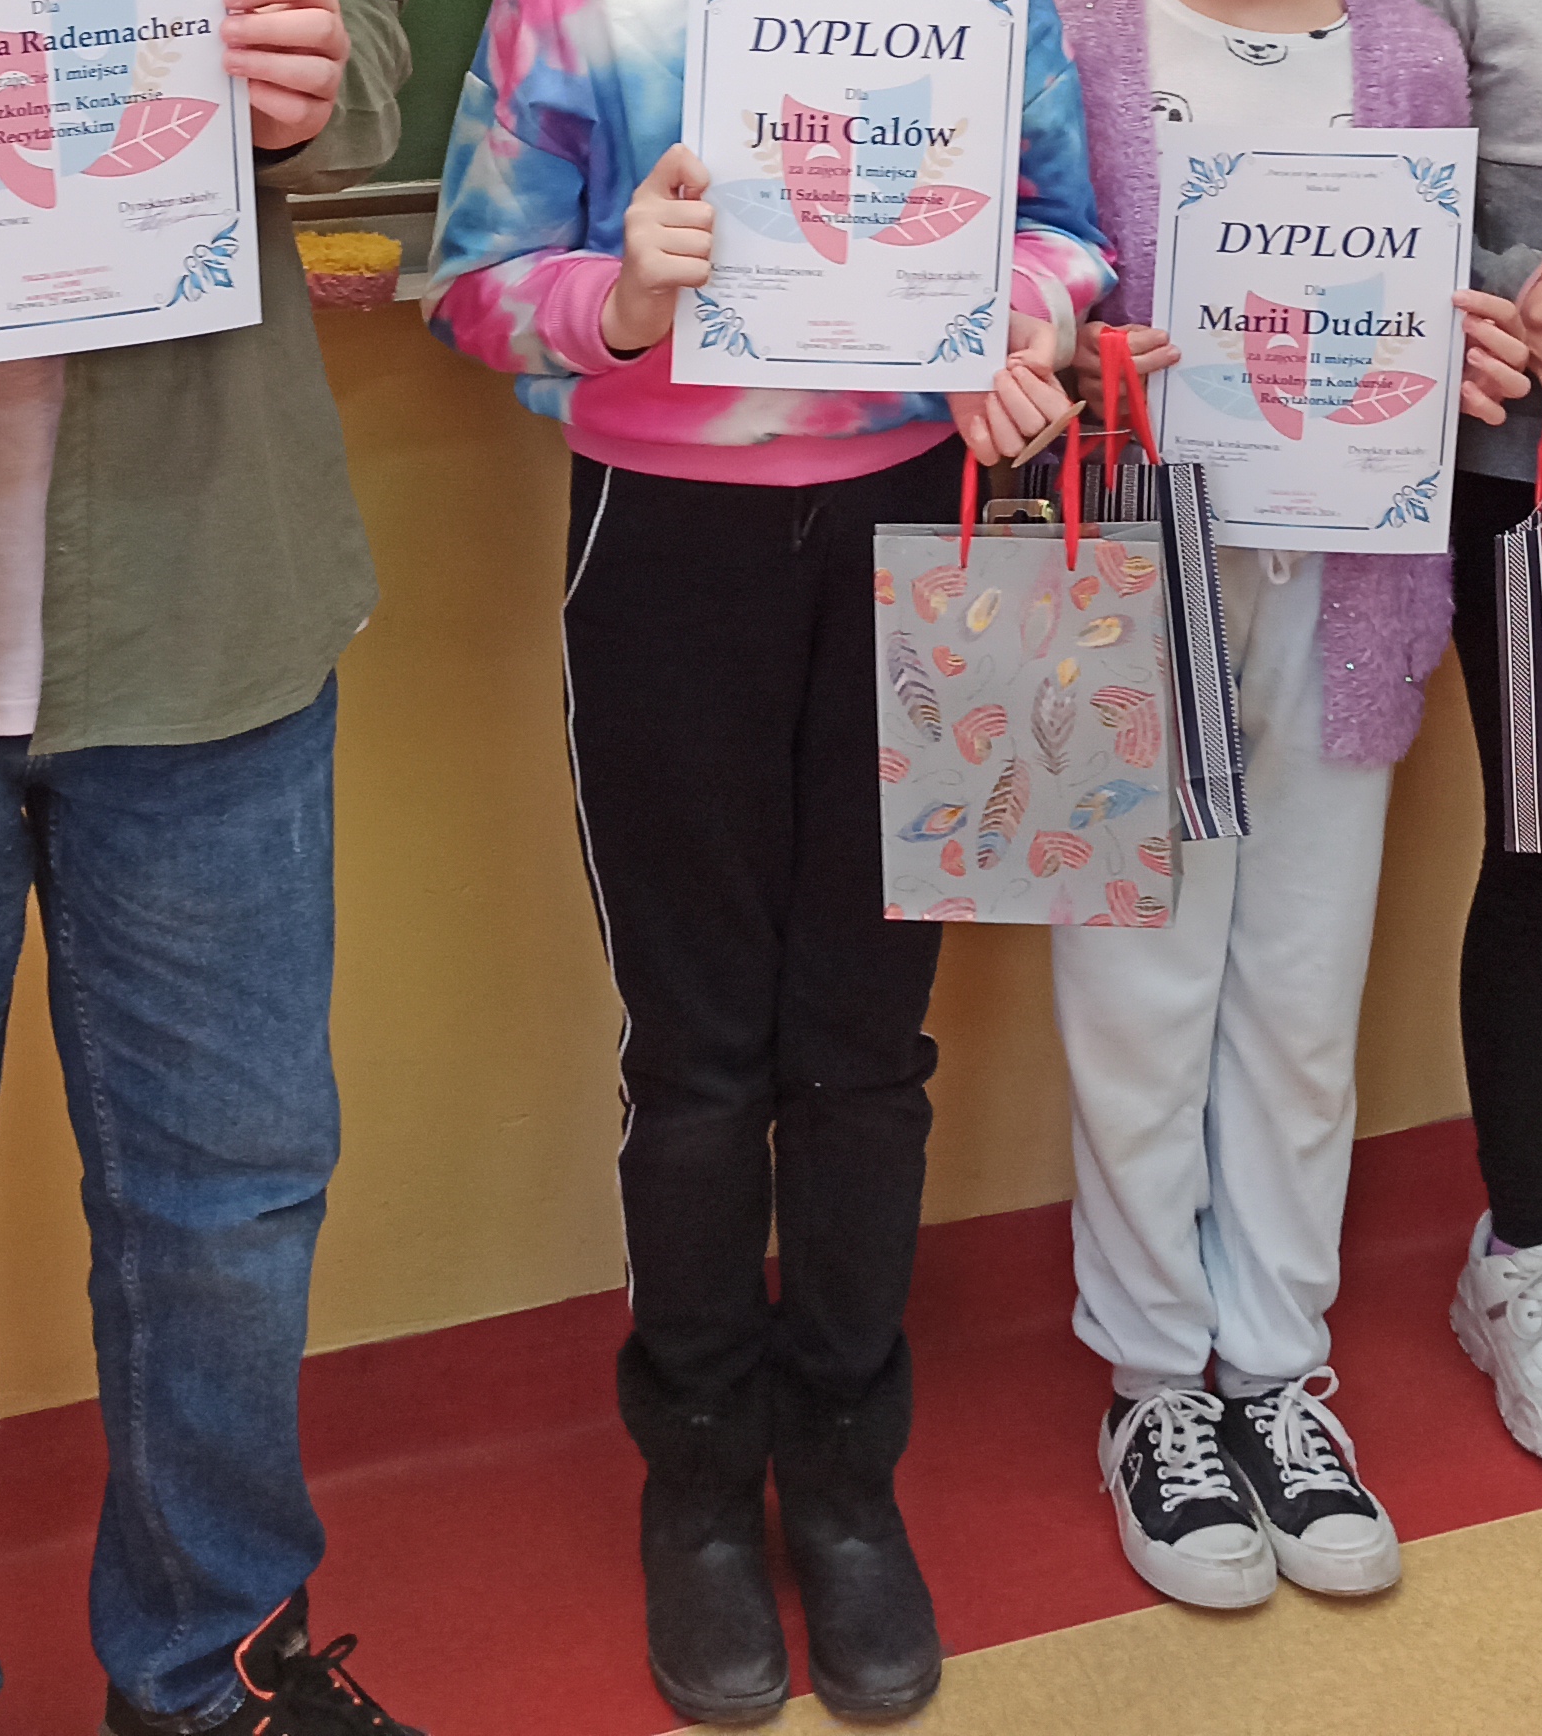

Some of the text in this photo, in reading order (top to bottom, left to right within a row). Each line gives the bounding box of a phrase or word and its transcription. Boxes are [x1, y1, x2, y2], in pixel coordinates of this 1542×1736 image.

[31, 0, 60, 14] Dla
[19, 17, 211, 53] Rademachera
[749, 17, 971, 60] DYPLOM
[54, 68, 61, 82] I
[66, 63, 129, 80] miejsca
[76, 89, 163, 110] Konkursie
[845, 88, 869, 100] Dla
[751, 112, 956, 148] Julii Calów
[865, 166, 917, 181] miejsca
[1216, 221, 1422, 259] DYPLOM
[1198, 304, 1426, 337] Marii Dudzik
